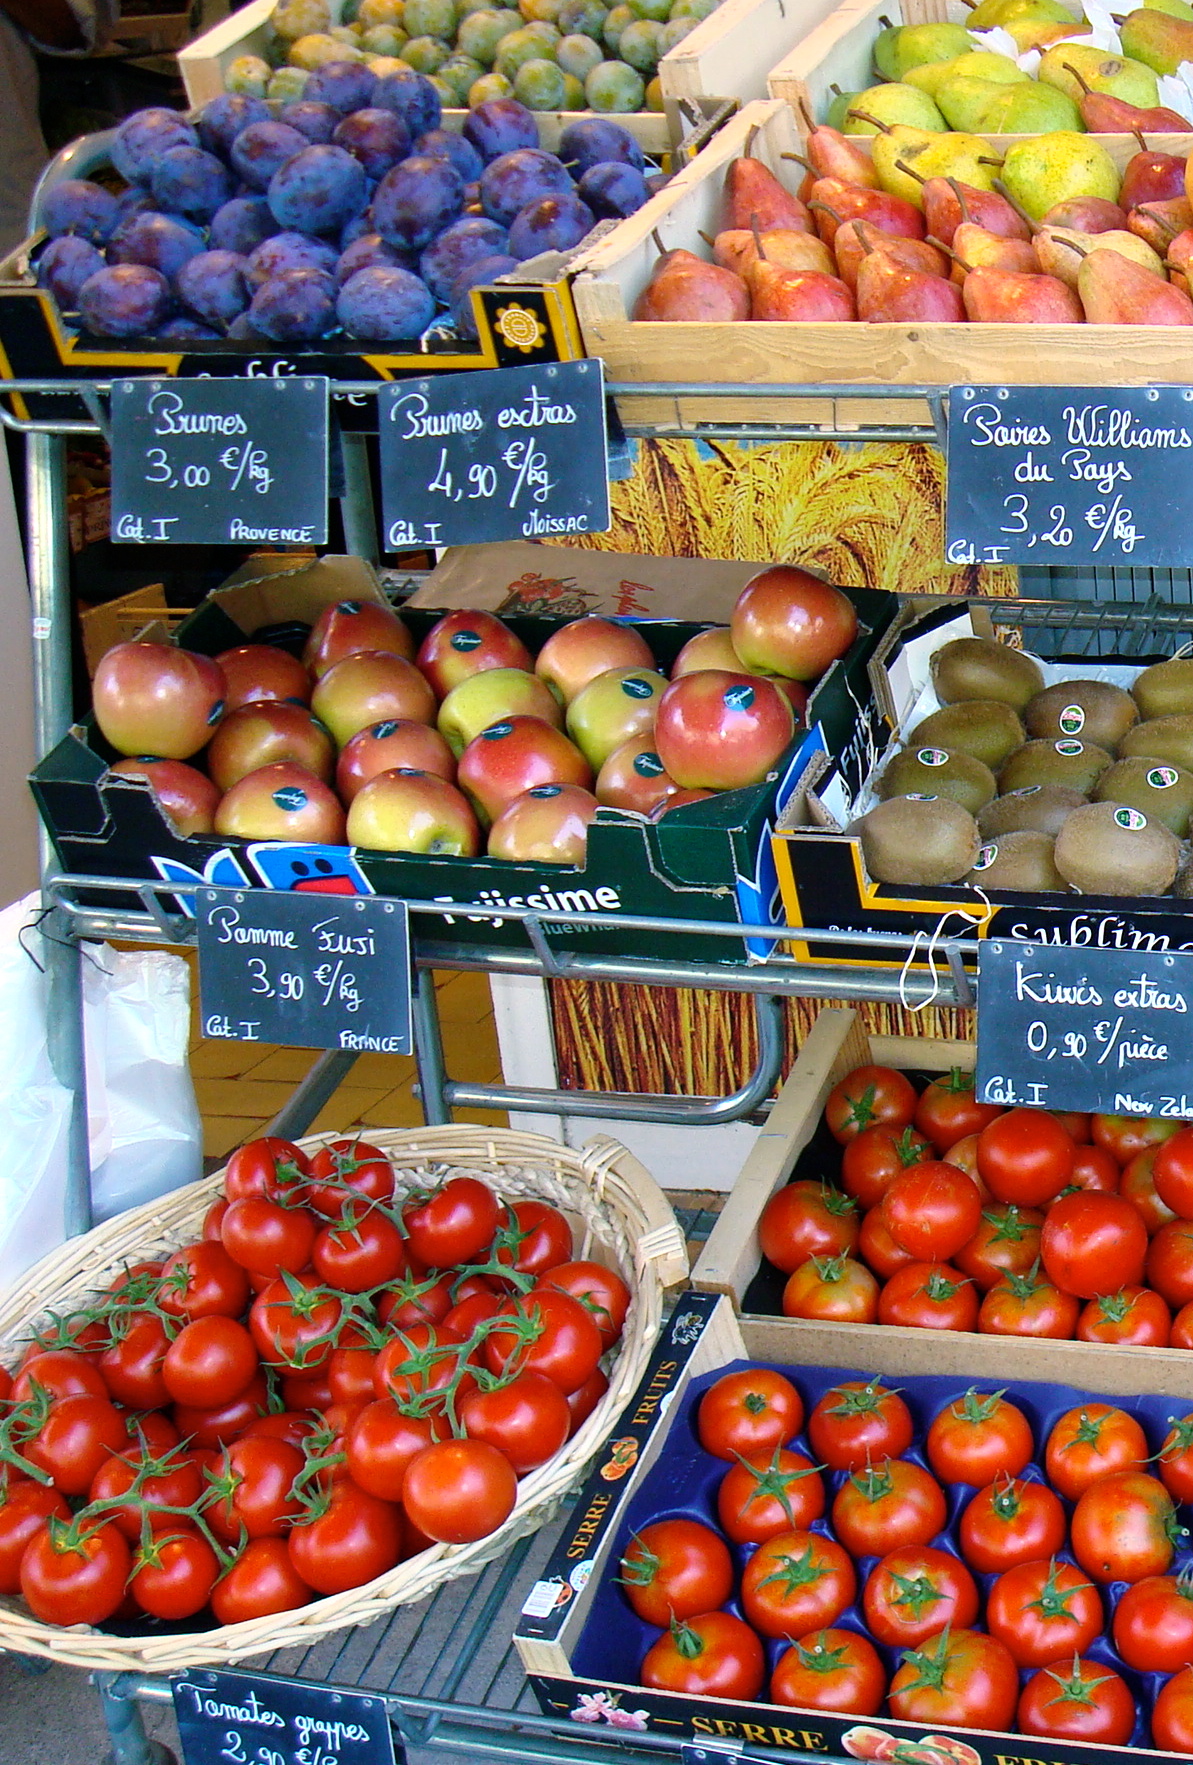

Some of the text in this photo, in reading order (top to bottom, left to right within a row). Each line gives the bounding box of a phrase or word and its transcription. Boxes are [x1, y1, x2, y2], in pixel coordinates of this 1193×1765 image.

[963, 403, 1193, 449] Poires Williams
[145, 448, 211, 488] 3,00
[428, 447, 498, 502] 4,90
[1014, 448, 1133, 494] du Pays
[230, 518, 316, 542] PROVENCE
[1000, 493, 1074, 548] 3,20
[247, 958, 305, 1000] 3,90
[1015, 960, 1188, 1013] Kiwis extras
[339, 1028, 405, 1052] FRANCE
[1026, 1020, 1088, 1060] 0,90
[1114, 1093, 1154, 1114] New
[630, 1359, 678, 1426] FRUITS
[566, 1492, 613, 1560] SERRE
[176, 1682, 370, 1751] Tomates grappes
[690, 1716, 829, 1752] SERRE
